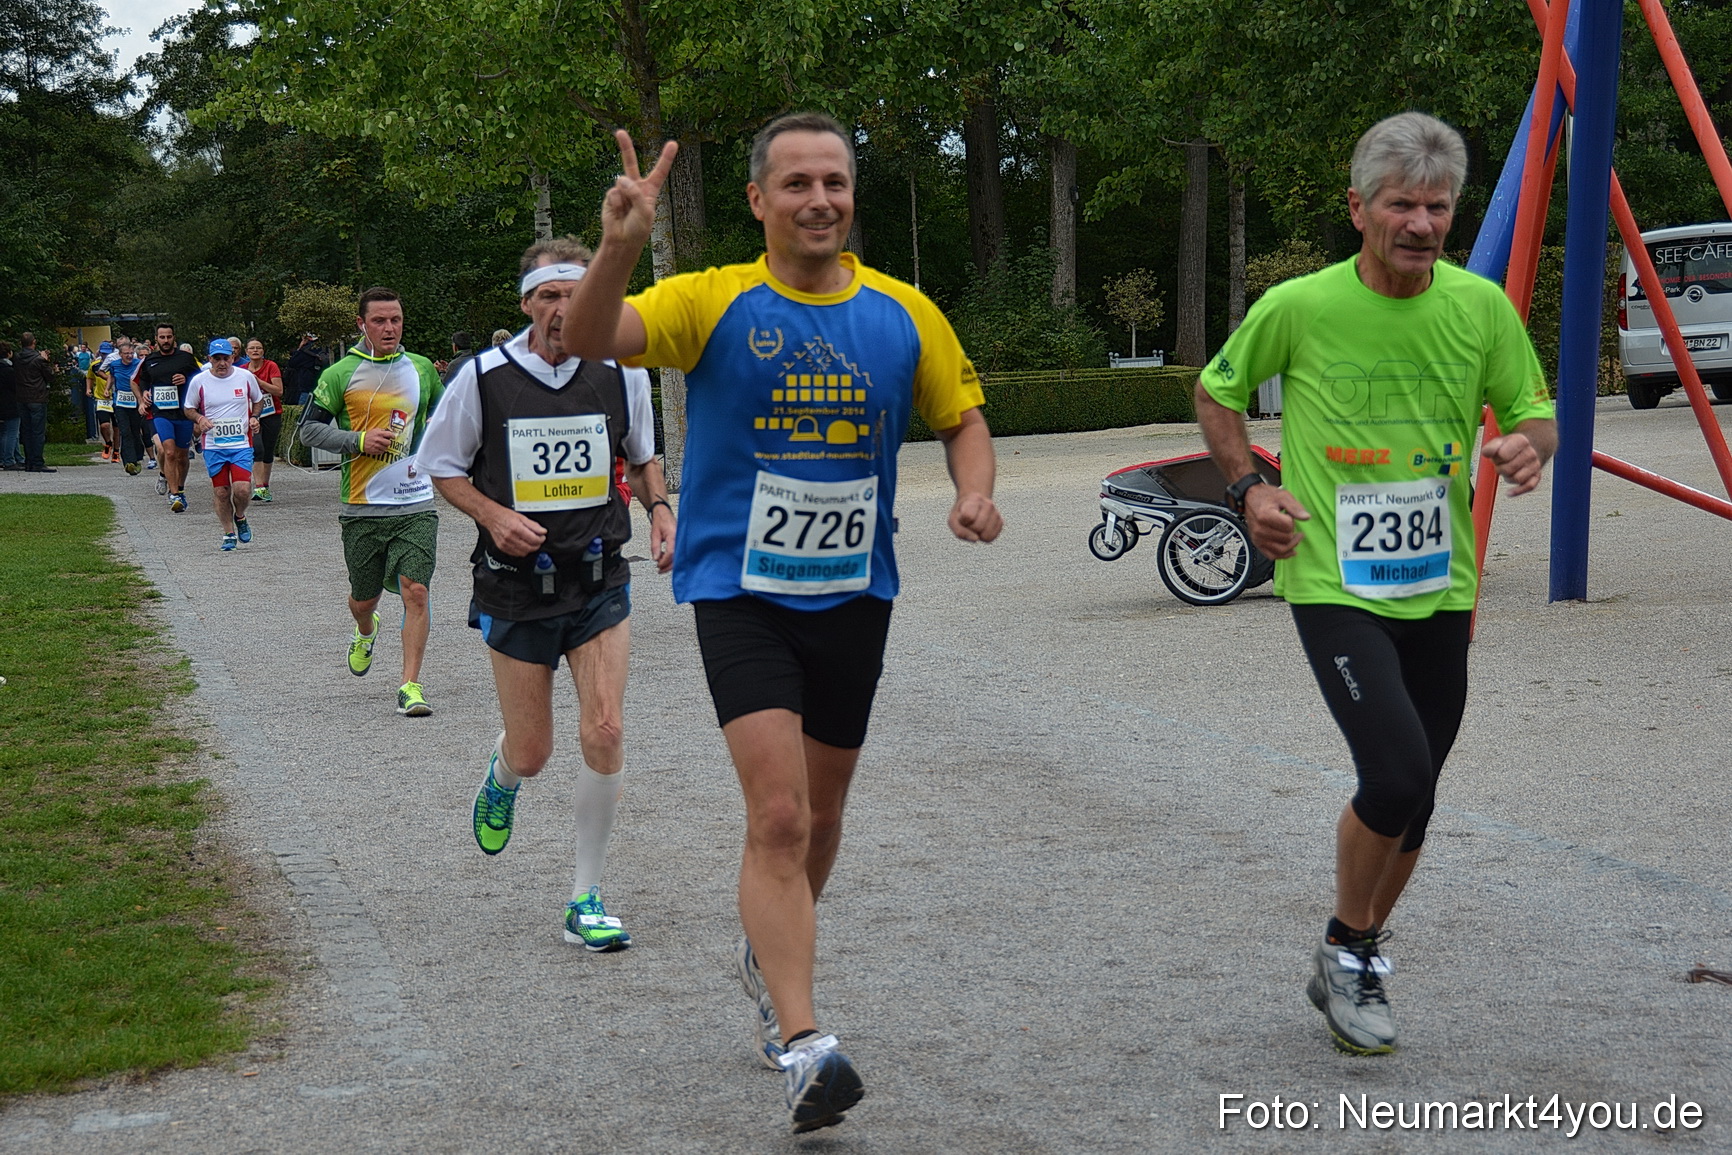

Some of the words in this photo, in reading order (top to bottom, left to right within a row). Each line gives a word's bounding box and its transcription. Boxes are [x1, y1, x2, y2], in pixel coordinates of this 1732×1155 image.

[1706, 339, 1717, 347] 22
[156, 392, 176, 401] 2380
[1318, 359, 1468, 419] OPF
[216, 423, 242, 436] 3003
[512, 429, 546, 438] PARTL
[548, 427, 593, 437] Neumarkt
[532, 440, 592, 475] 323
[1325, 446, 1390, 464] MERZ
[544, 484, 584, 498] Lothar
[759, 483, 799, 503] PARTL
[803, 493, 860, 505] Neumarkt
[1339, 494, 1382, 505] PARTL
[1386, 491, 1434, 505] Neumarkt
[763, 505, 866, 550] 2726
[1351, 505, 1443, 552] 2384
[1370, 561, 1429, 581] Michael
